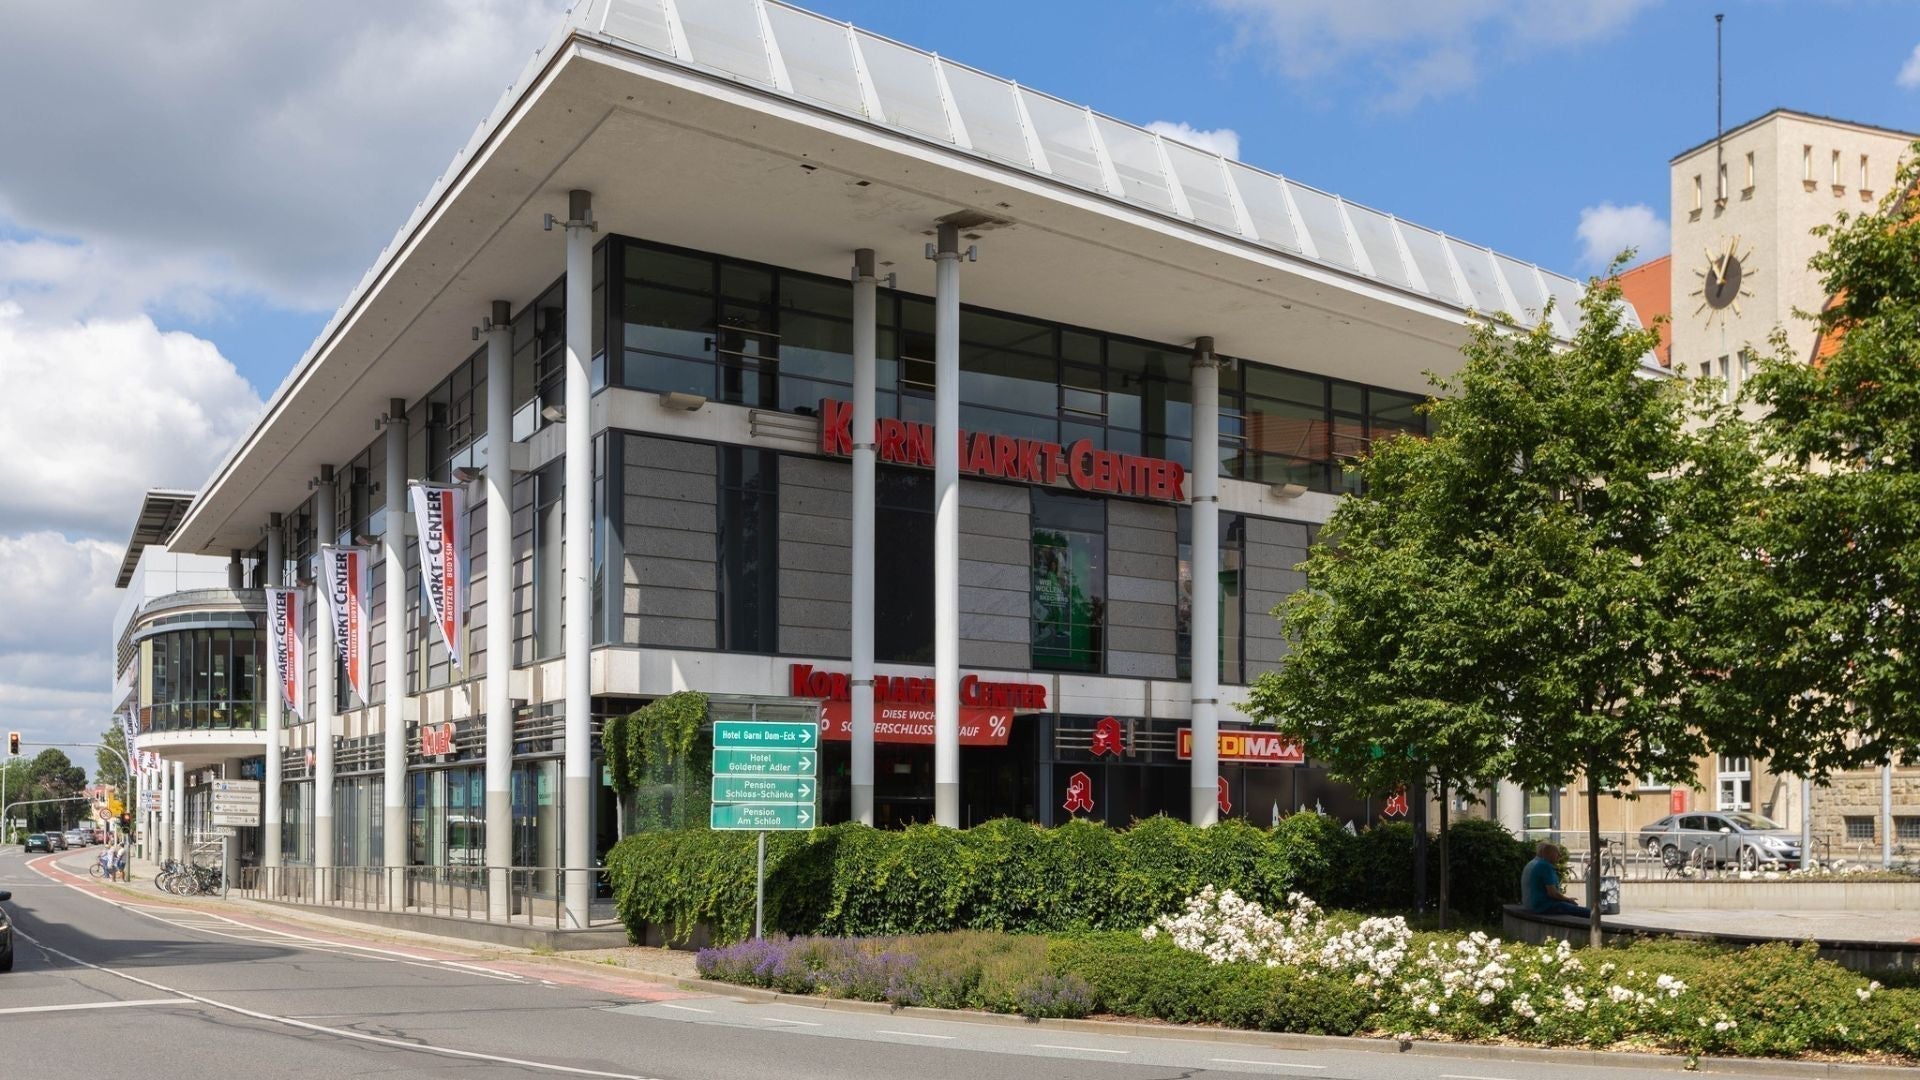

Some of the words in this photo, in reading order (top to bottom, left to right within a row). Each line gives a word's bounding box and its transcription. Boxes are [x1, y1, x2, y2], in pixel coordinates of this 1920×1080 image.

[820, 398, 1185, 502] KRNARKT-CENTER
[882, 709, 907, 719] DIESE
[909, 710, 936, 720] WOCH
[840, 720, 980, 737] SOERSCHLUSSAUF
[722, 730, 741, 740] Hotel
[743, 730, 762, 740] Garni
[764, 731, 796, 741] Dom-Eck
[1183, 734, 1300, 757] DIMAX
[750, 754, 771, 762] Hotel
[729, 762, 766, 771] Goldener
[769, 763, 791, 772] Adler
[744, 780, 776, 789] Pension
[725, 789, 794, 799] Schloss-Schänke
[743, 807, 775, 816] Pension
[737, 817, 752, 825] Am
[754, 817, 781, 825] Schloß
